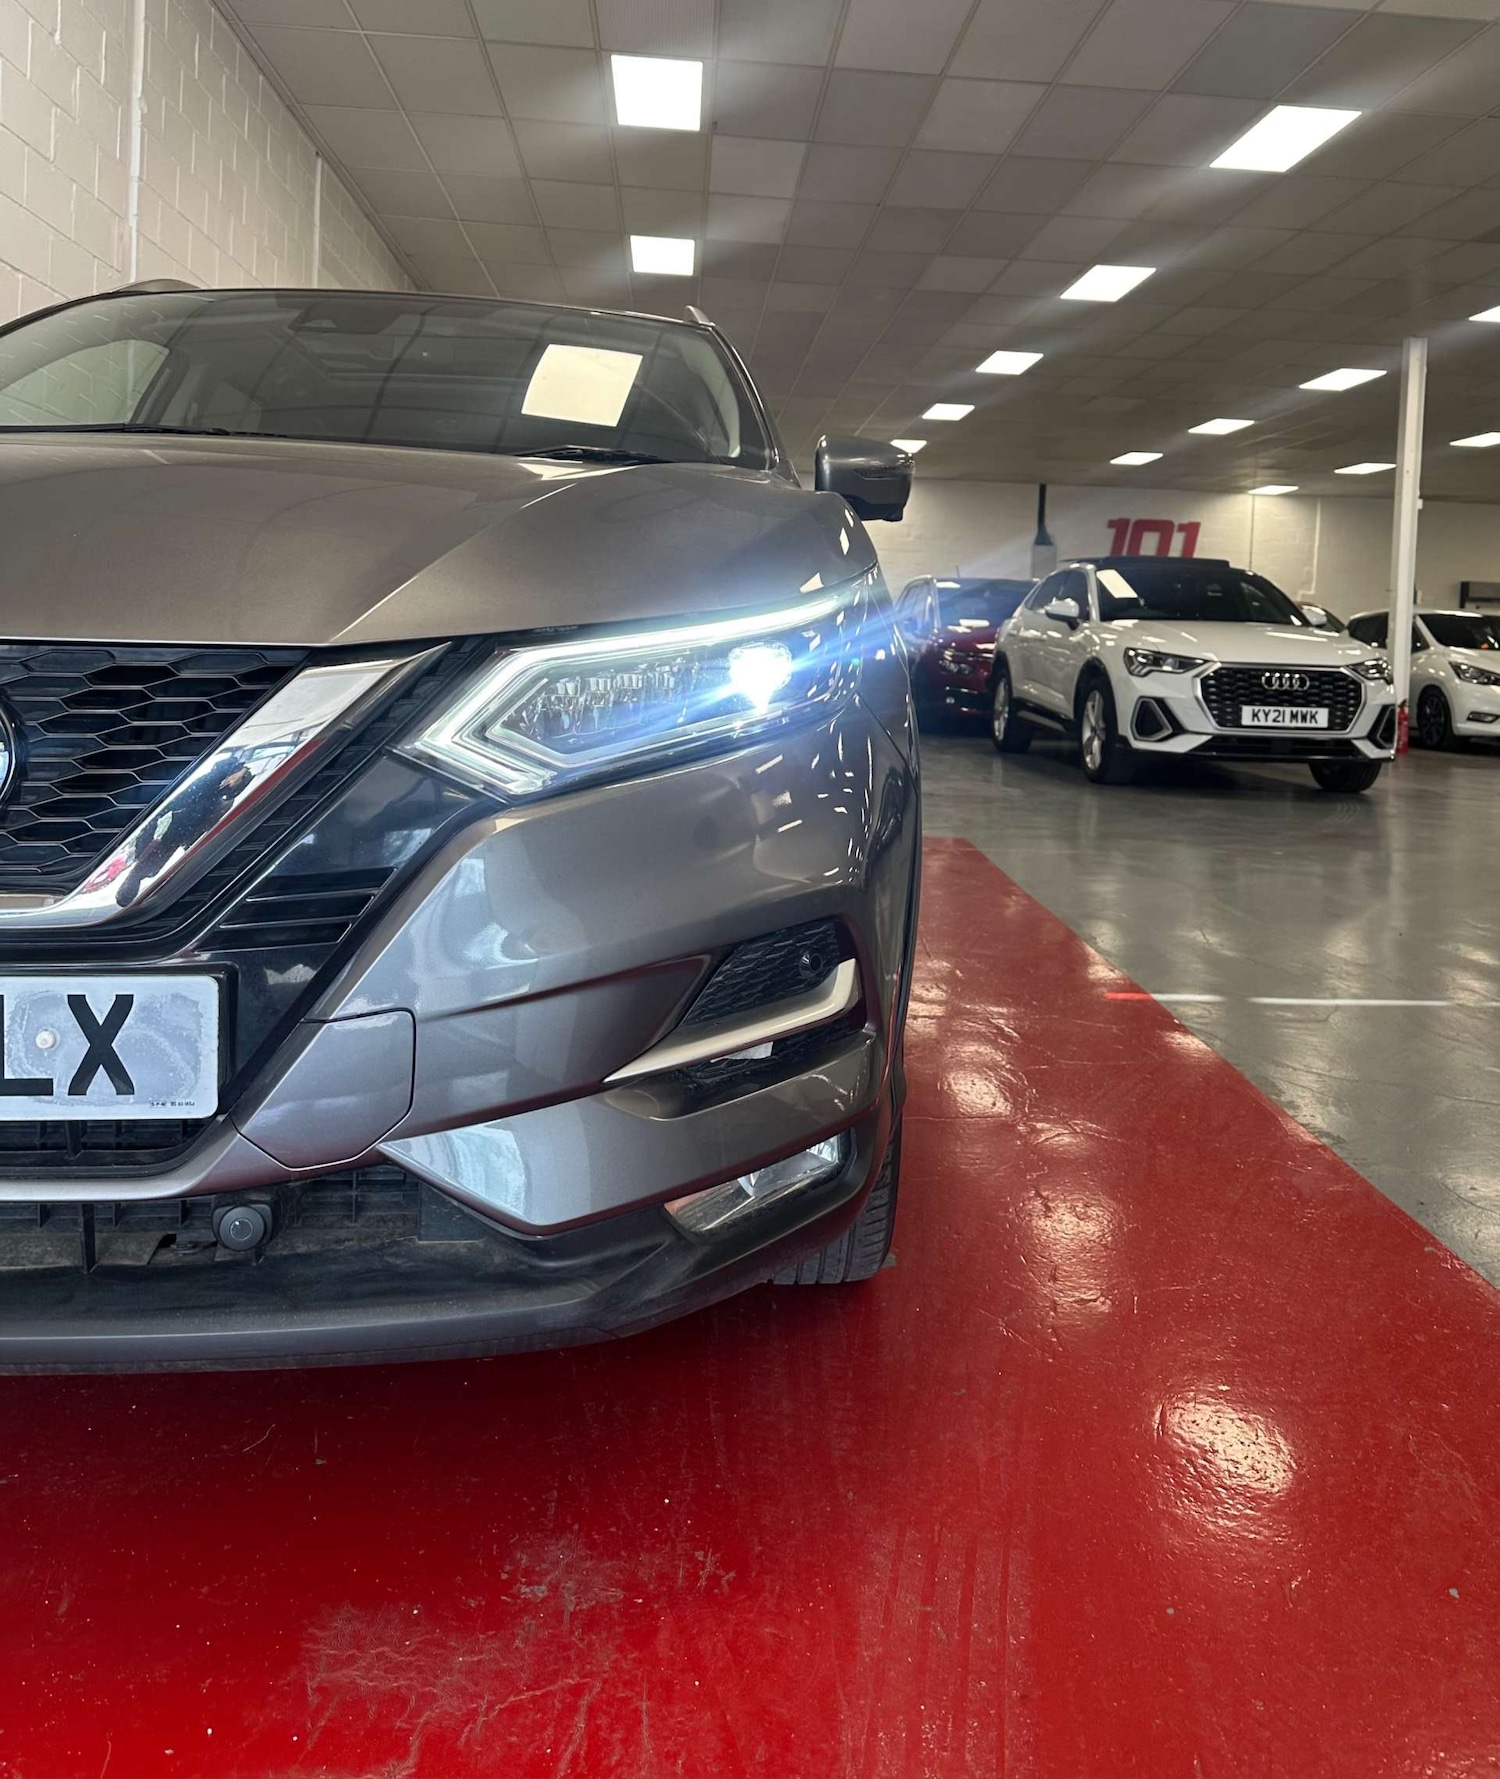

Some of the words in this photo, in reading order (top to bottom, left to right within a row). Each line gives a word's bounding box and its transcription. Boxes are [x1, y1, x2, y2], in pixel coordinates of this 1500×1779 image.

[1107, 518, 1201, 558] 101
[1251, 708, 1285, 723] KY21
[1289, 709, 1319, 724] MWK
